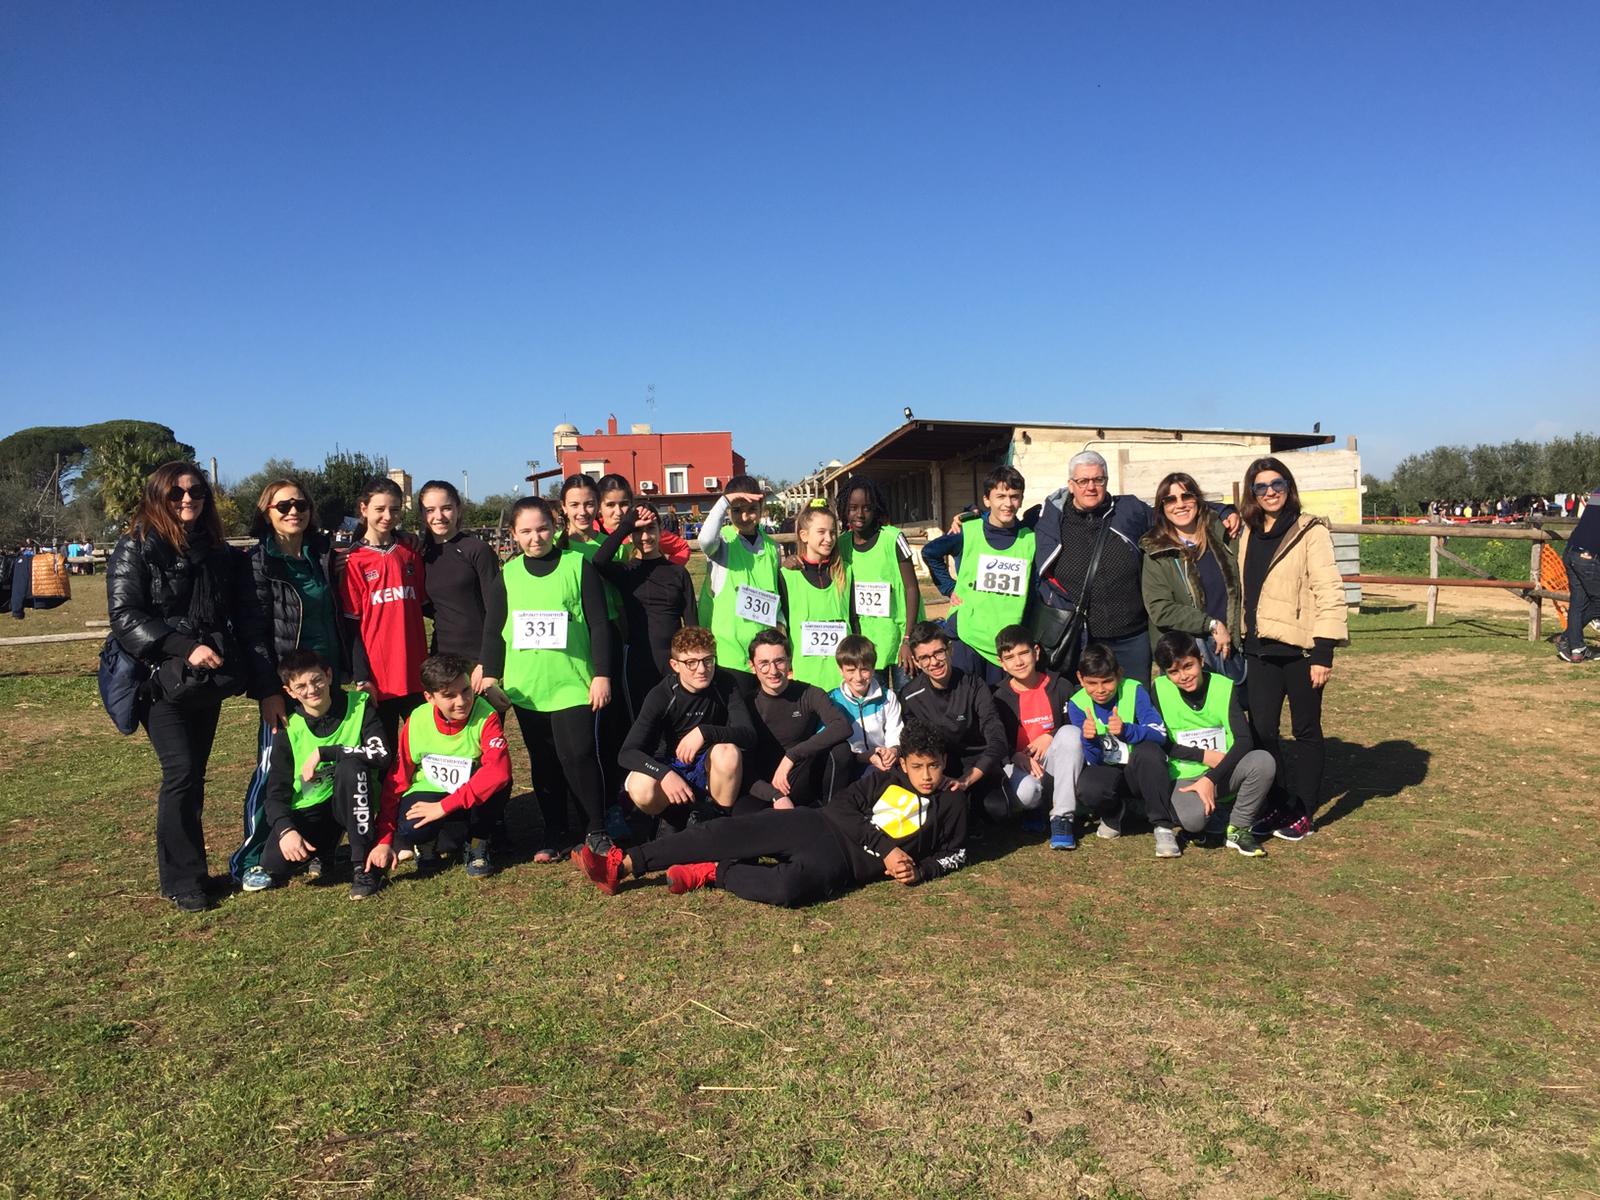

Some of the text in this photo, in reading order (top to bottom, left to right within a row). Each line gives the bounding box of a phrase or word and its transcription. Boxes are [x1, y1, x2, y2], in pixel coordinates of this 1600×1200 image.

[983, 572, 1020, 592] 831
[371, 586, 416, 606] KENYA
[744, 596, 770, 615] 330
[859, 592, 882, 606] 332
[525, 621, 555, 637] 331
[811, 632, 839, 646] 329
[431, 765, 459, 785] 330
[353, 771, 370, 835] adidas
